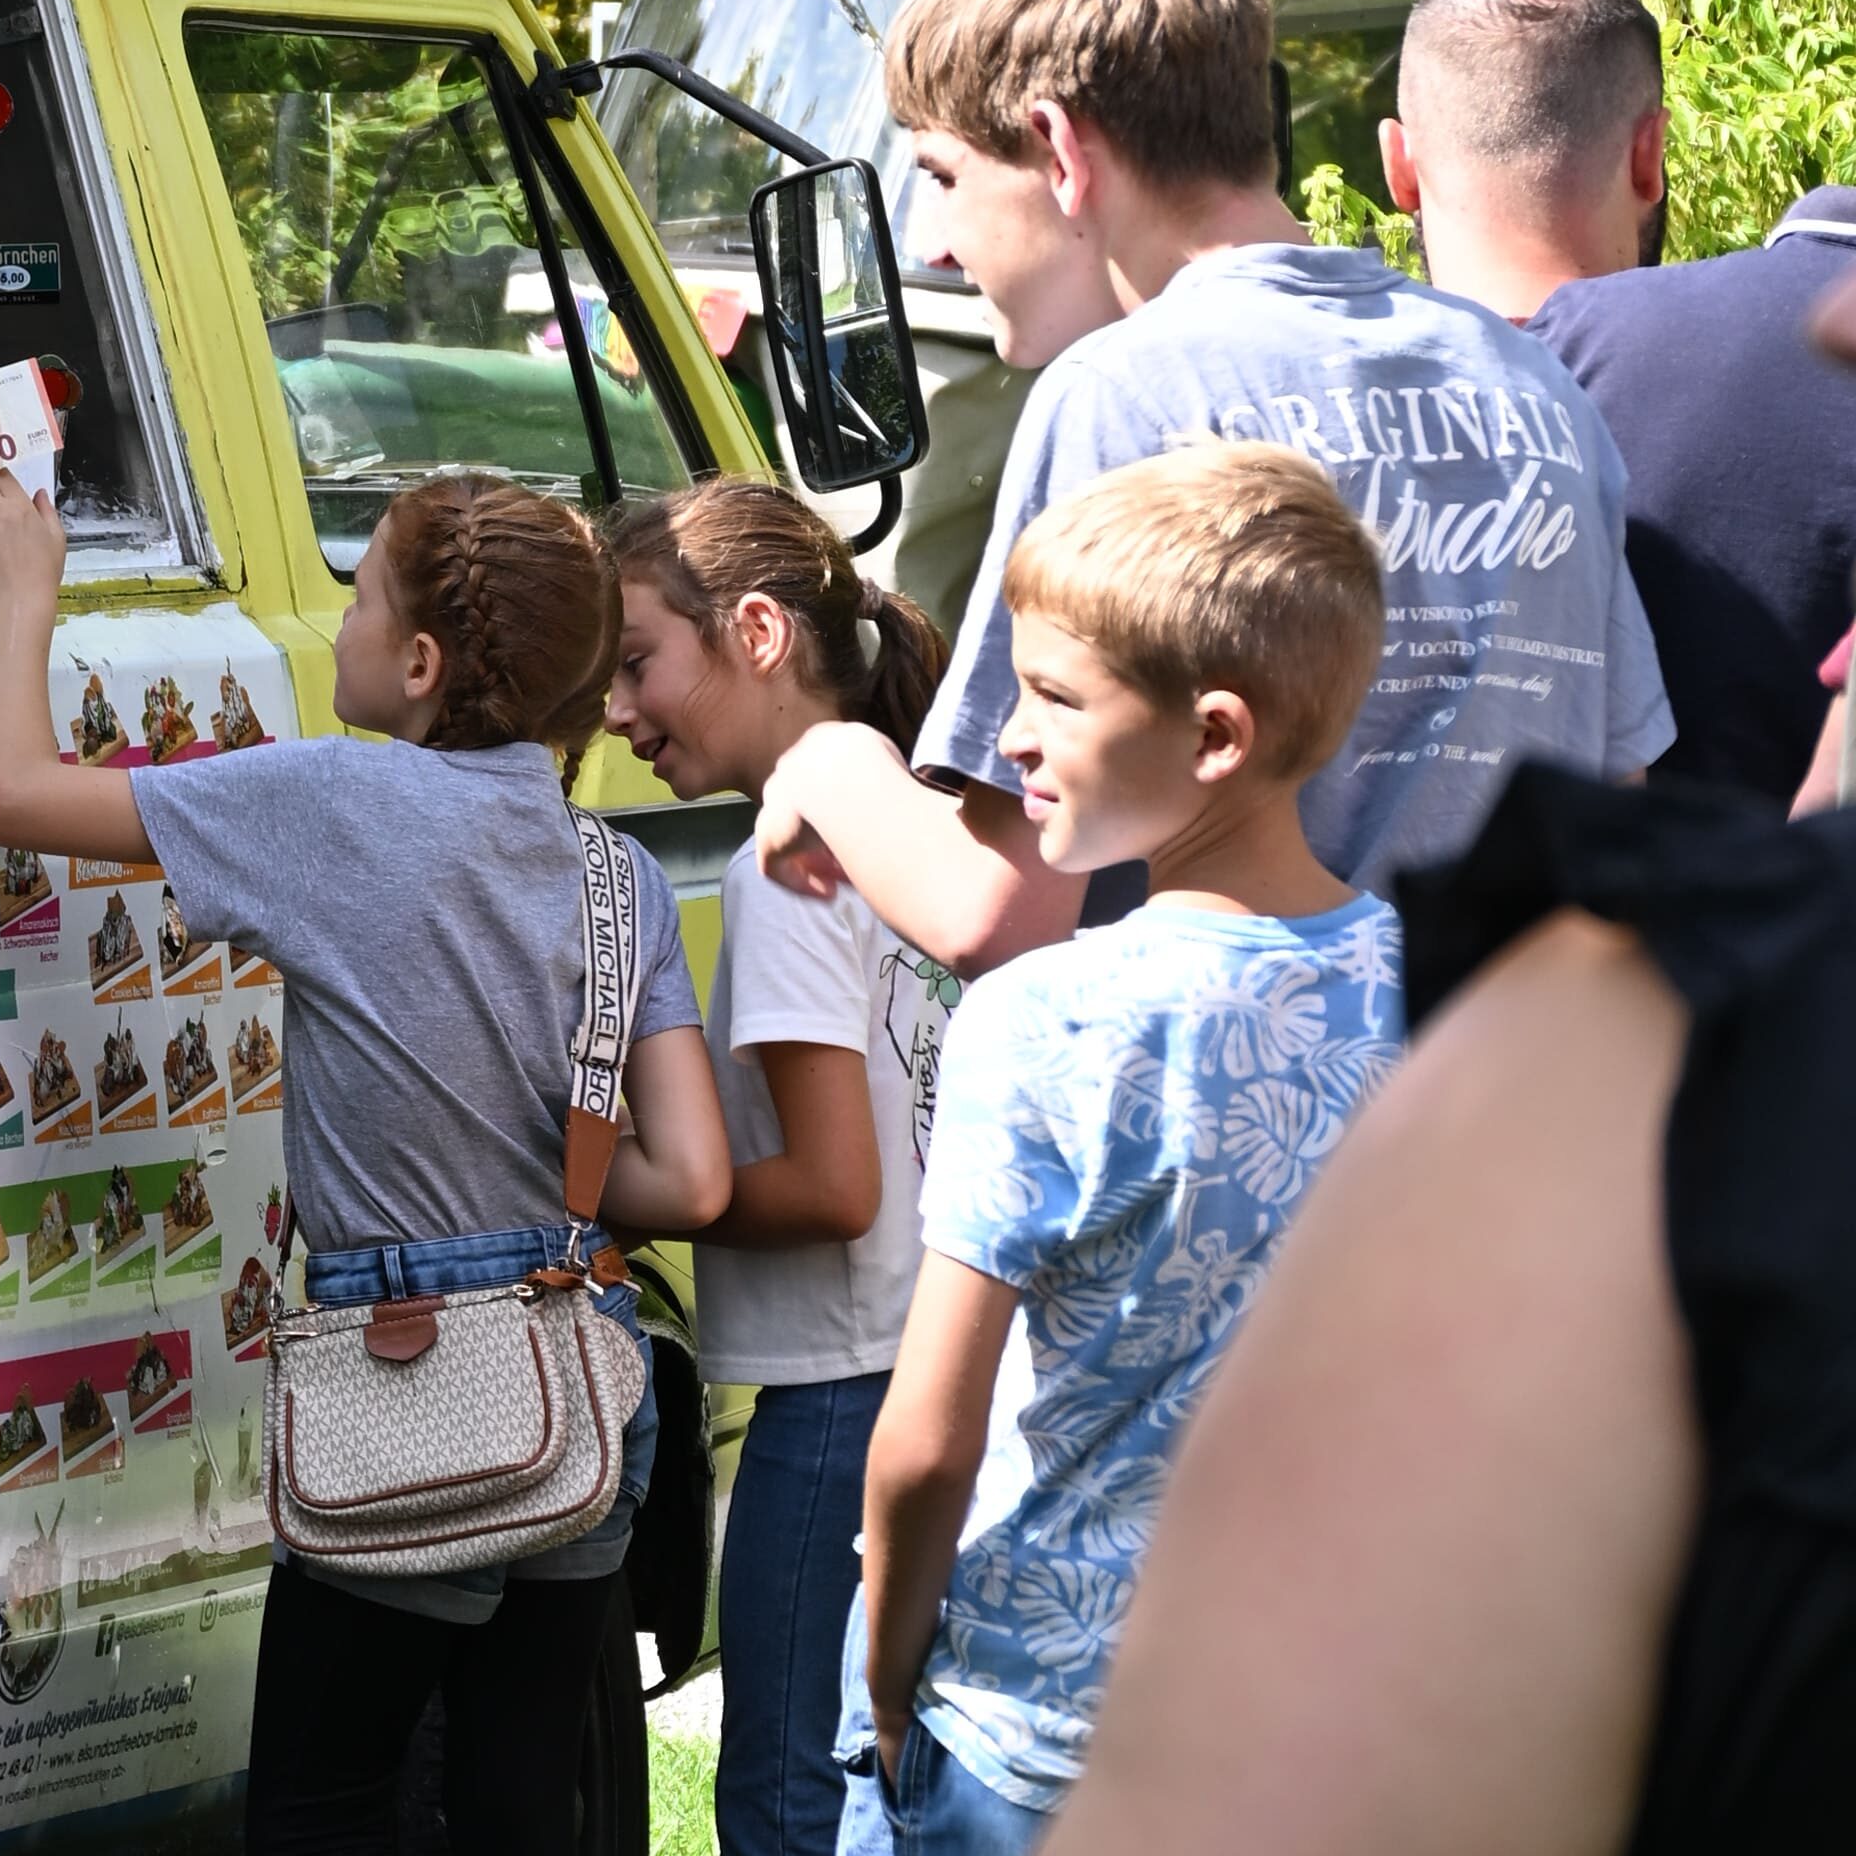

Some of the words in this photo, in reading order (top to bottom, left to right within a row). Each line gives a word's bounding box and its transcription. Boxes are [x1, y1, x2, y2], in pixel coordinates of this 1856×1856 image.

[582, 830, 610, 910] KORS
[594, 916, 620, 1048] MICHAEL
[3, 1715, 24, 1748] ein
